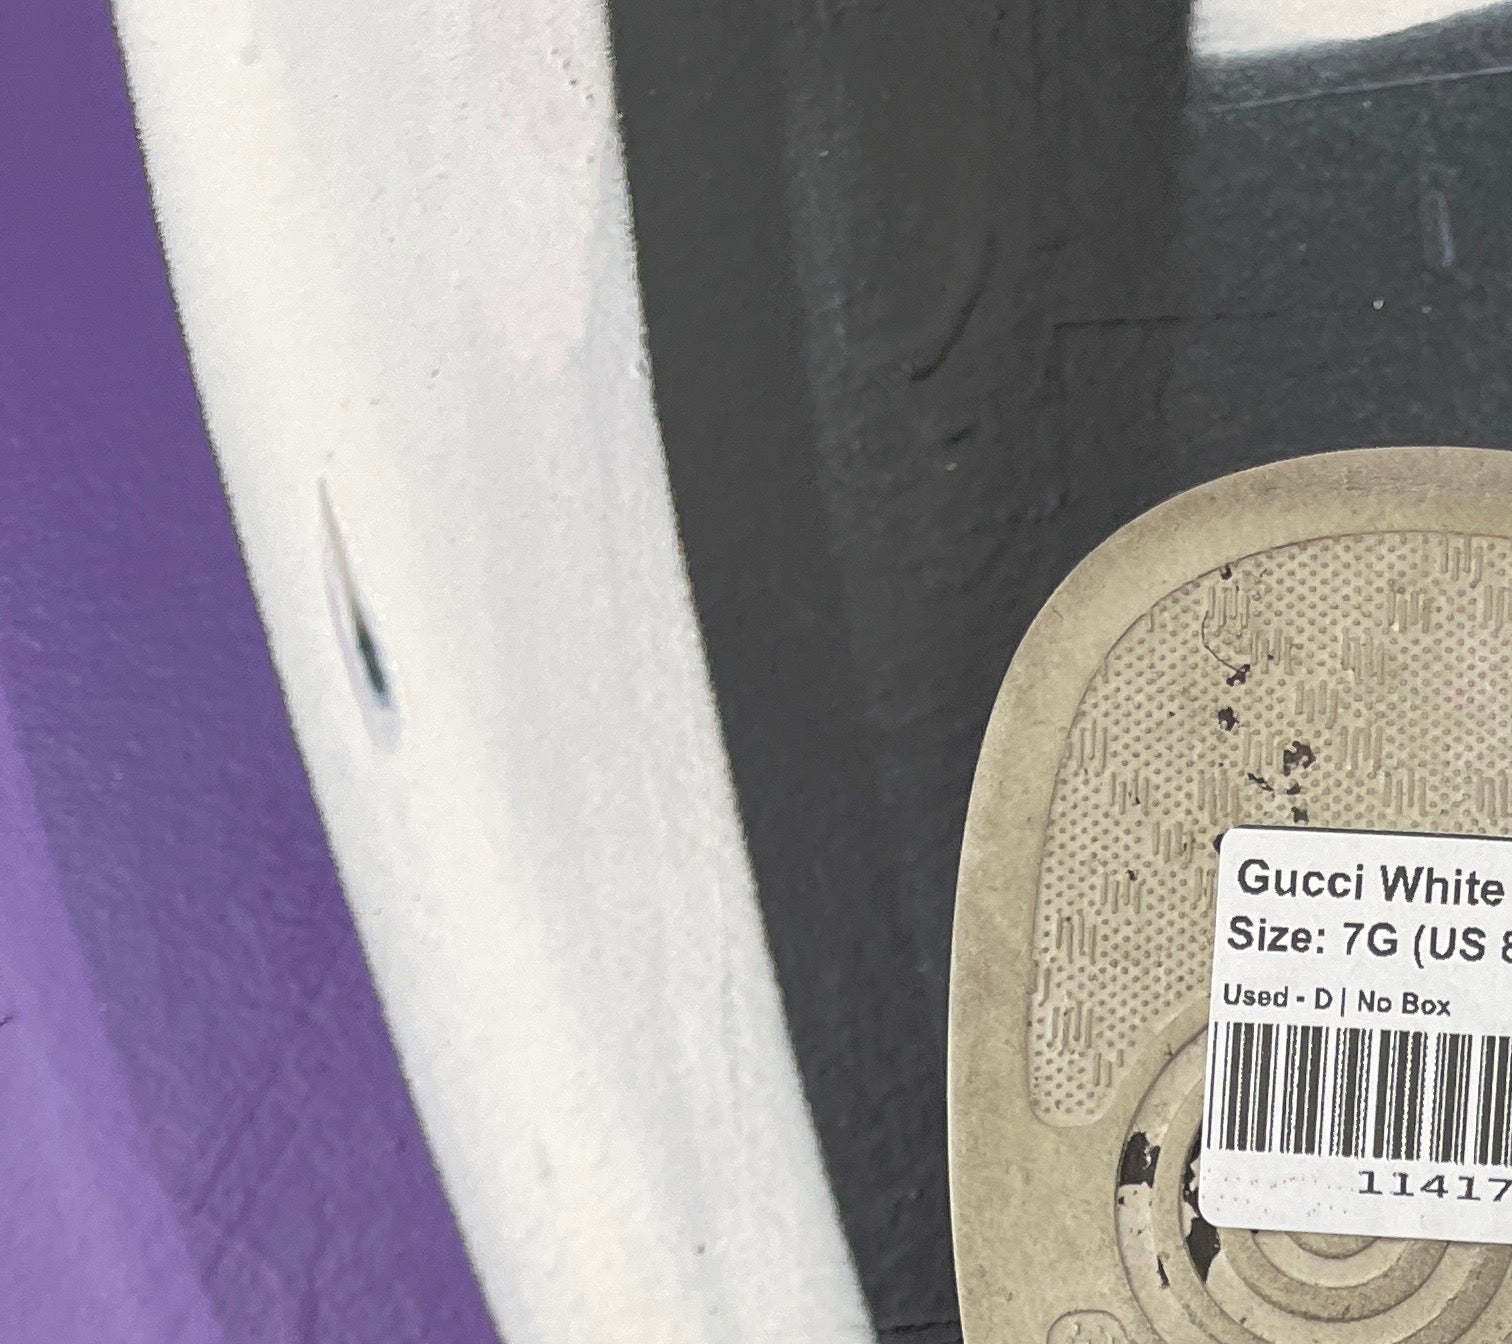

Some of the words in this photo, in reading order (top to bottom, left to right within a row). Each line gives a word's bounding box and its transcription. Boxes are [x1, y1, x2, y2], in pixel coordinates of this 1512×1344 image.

[1238, 859, 1363, 899] Gucci
[1381, 866, 1504, 906] White
[1228, 916, 1324, 953] Size:
[1344, 923, 1397, 956] 7G
[1414, 925, 1485, 968] (US
[1224, 984, 1288, 1007] Used
[1315, 988, 1332, 1009] D
[1359, 990, 1391, 1012] No
[1402, 993, 1450, 1016] Box
